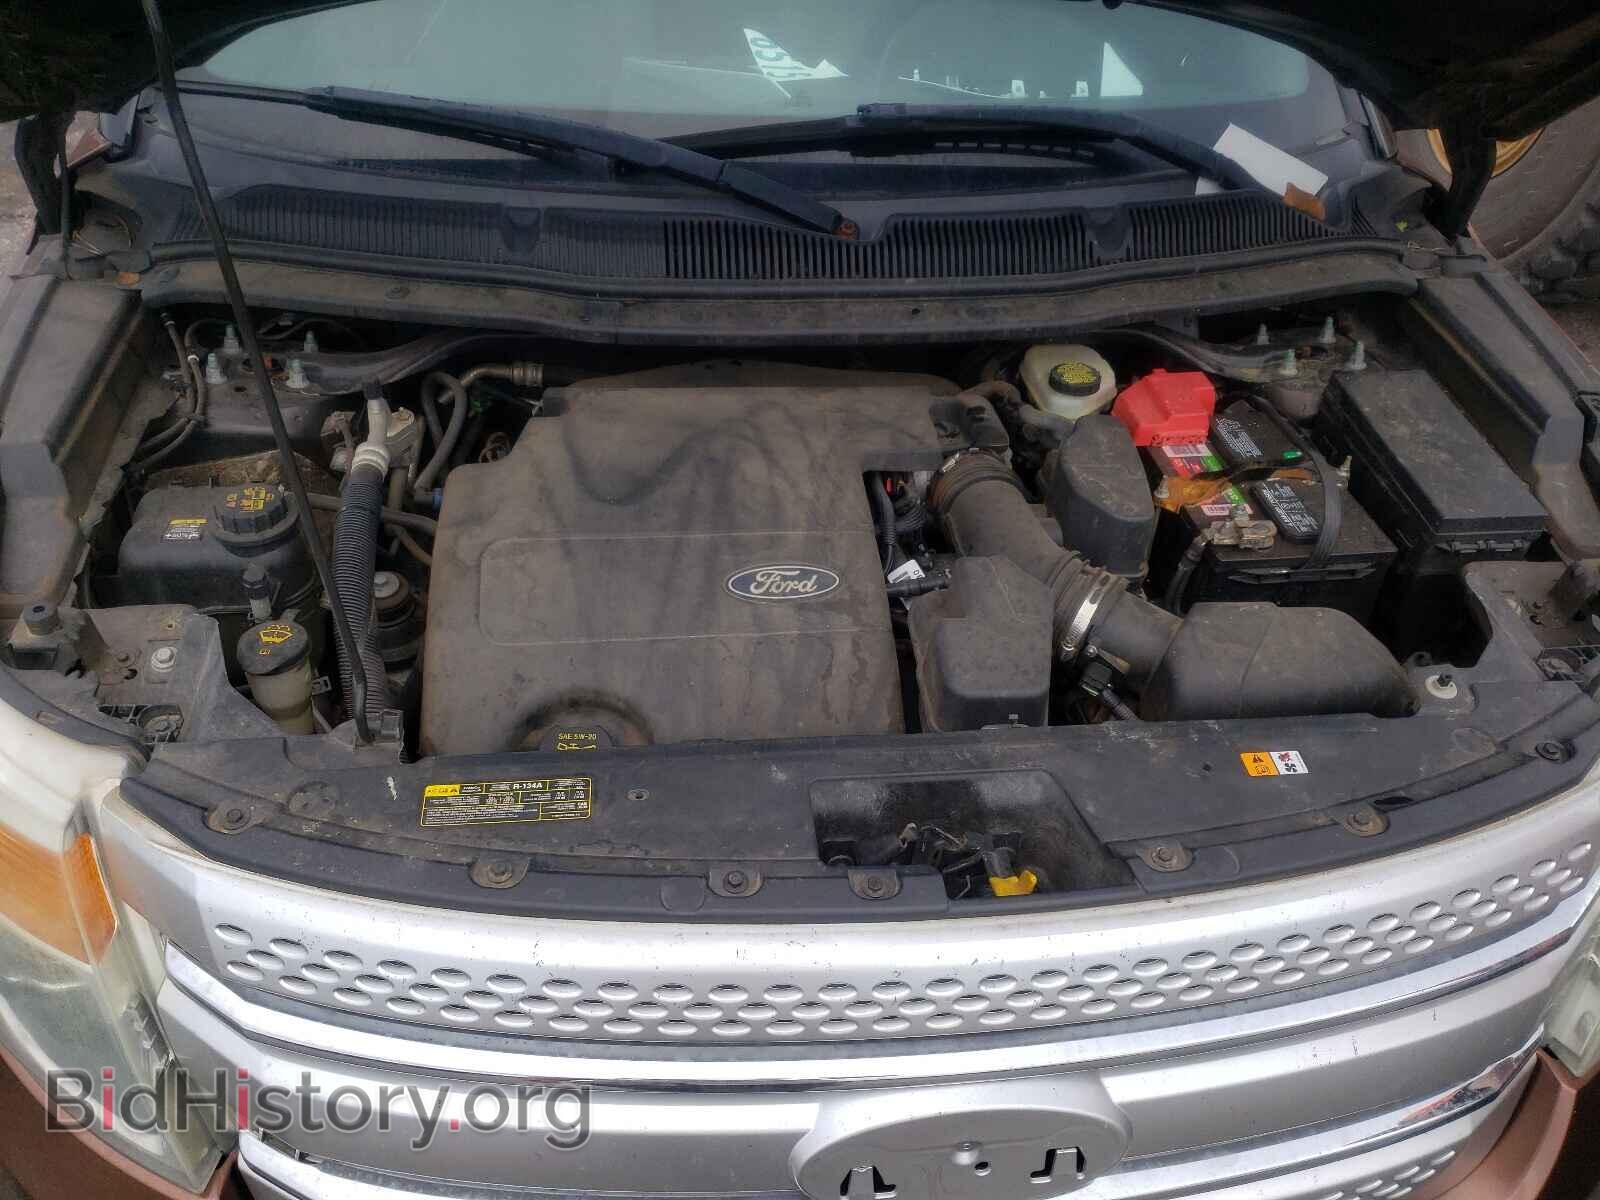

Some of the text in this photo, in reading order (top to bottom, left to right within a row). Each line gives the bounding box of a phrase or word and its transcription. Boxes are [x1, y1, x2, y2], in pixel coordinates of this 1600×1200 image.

[750, 570, 818, 594] Ford
[558, 732, 573, 740] SAE
[512, 782, 543, 790] R-134A
